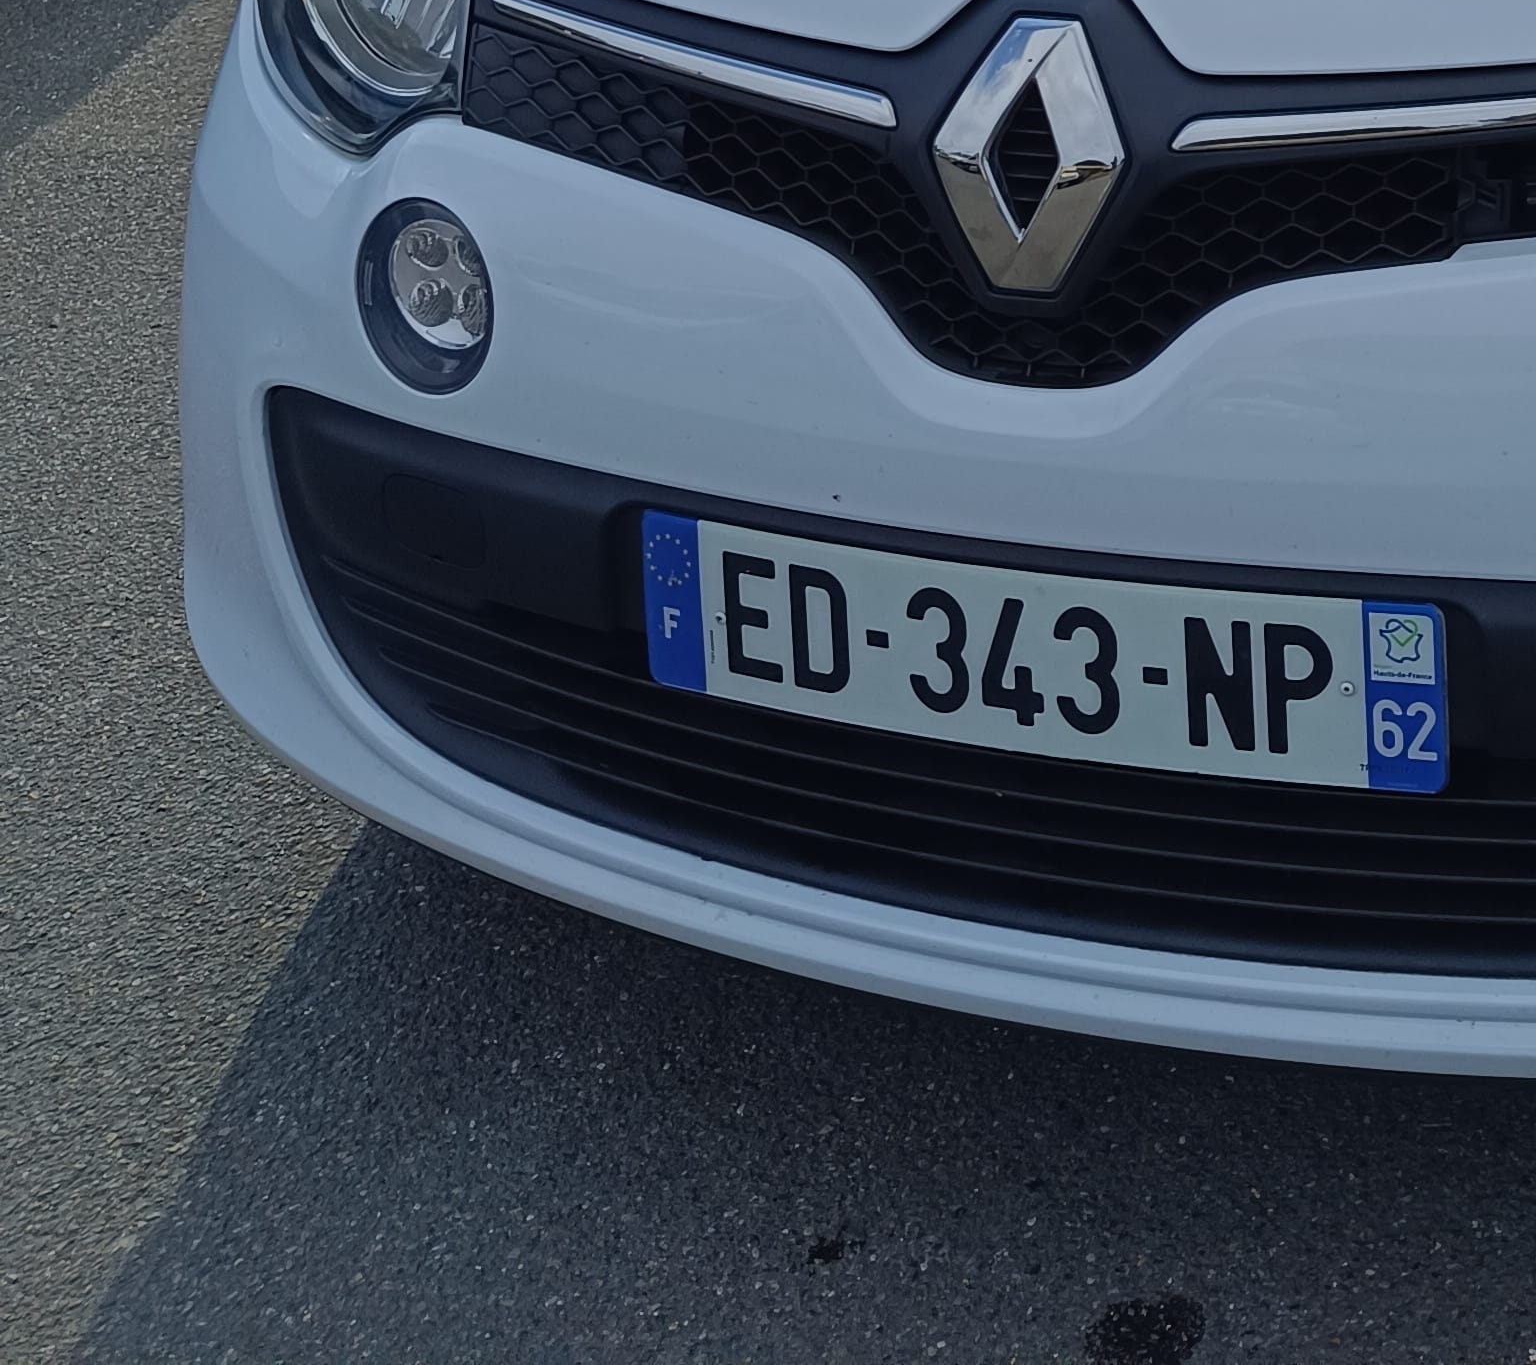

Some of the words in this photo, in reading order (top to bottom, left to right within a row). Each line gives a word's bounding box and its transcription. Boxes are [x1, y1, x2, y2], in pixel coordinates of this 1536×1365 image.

[662, 605, 681, 639] F
[722, 550, 1334, 755] ED-343-NP
[1372, 698, 1438, 762] 62
